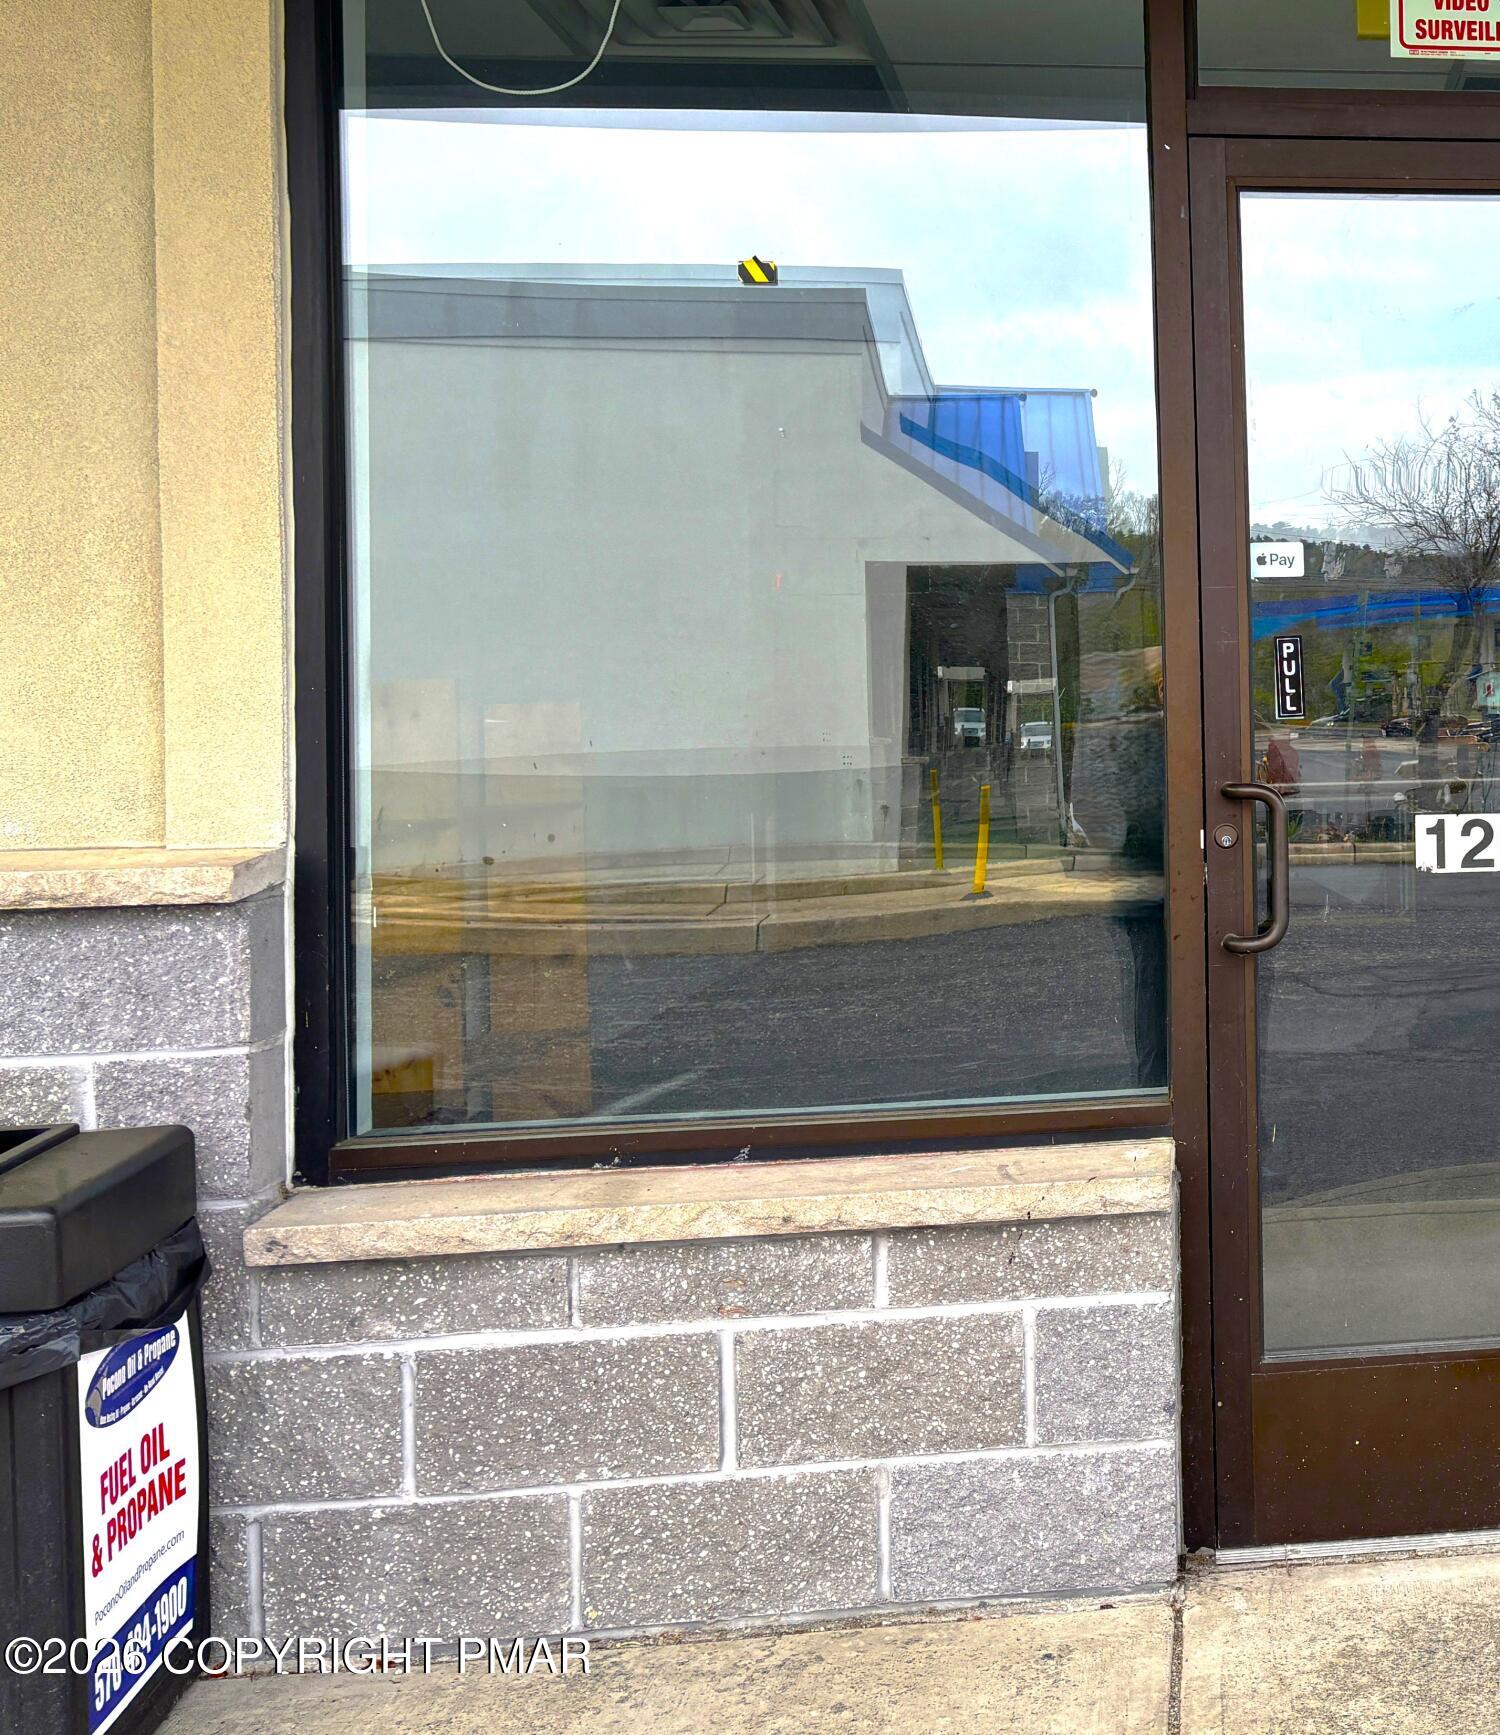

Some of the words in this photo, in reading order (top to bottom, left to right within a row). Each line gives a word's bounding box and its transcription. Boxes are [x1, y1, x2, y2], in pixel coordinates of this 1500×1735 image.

[1435, 0, 1489, 12] VIDEO
[1269, 553, 1295, 568] Pay
[1282, 642, 1296, 712] PULL
[102, 1365, 126, 1401] Pocono
[127, 1353, 136, 1379] Oil
[144, 1330, 176, 1366] Propane
[100, 1447, 136, 1515] FUEL
[140, 1422, 170, 1474] OIL
[92, 1533, 103, 1578] &
[107, 1457, 187, 1562] PROPANE
